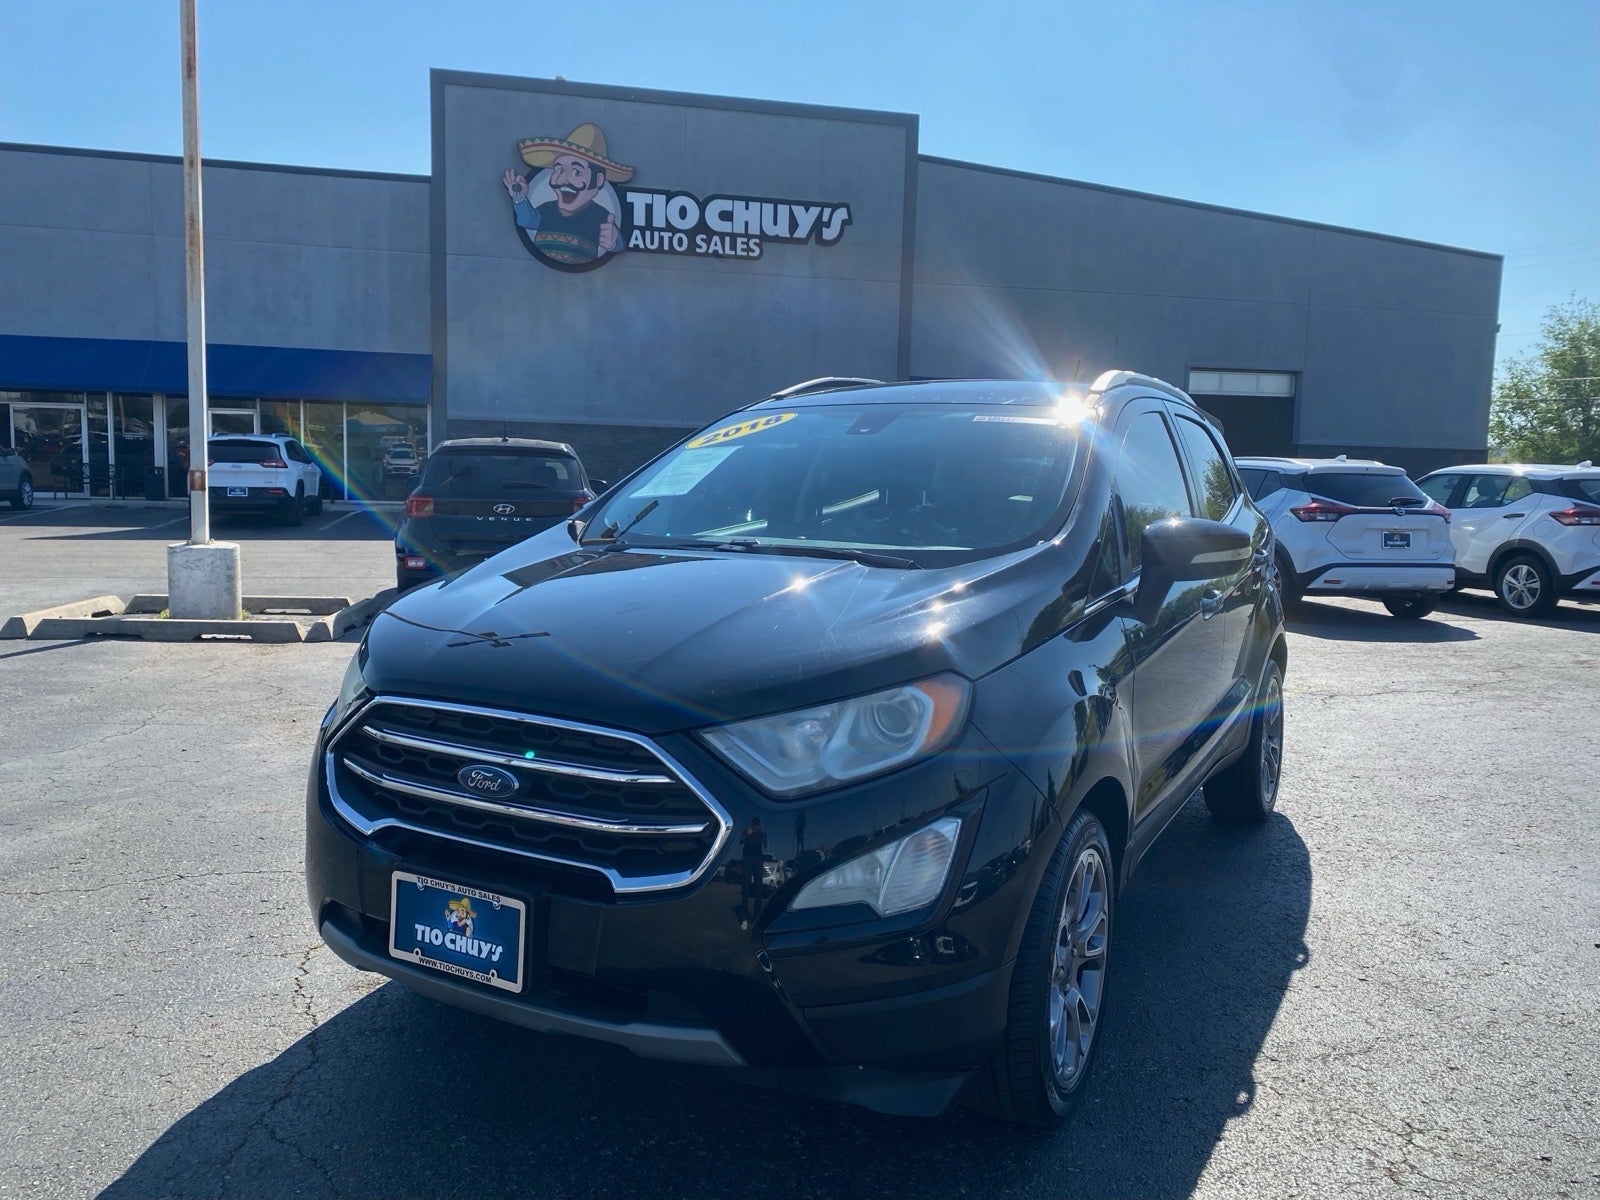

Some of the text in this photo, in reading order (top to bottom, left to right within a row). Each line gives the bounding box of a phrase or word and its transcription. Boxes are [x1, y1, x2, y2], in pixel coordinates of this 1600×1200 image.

[626, 191, 849, 240] TIO CHUY'S
[628, 229, 761, 257] AUTO SALES
[700, 415, 784, 446] 2018
[467, 769, 502, 792] Ford
[430, 879, 456, 891] CHUY'S
[457, 886, 477, 897] AUTO
[478, 891, 501, 903] SALES
[418, 957, 492, 983] WWW.TIOCHUYS.COM
